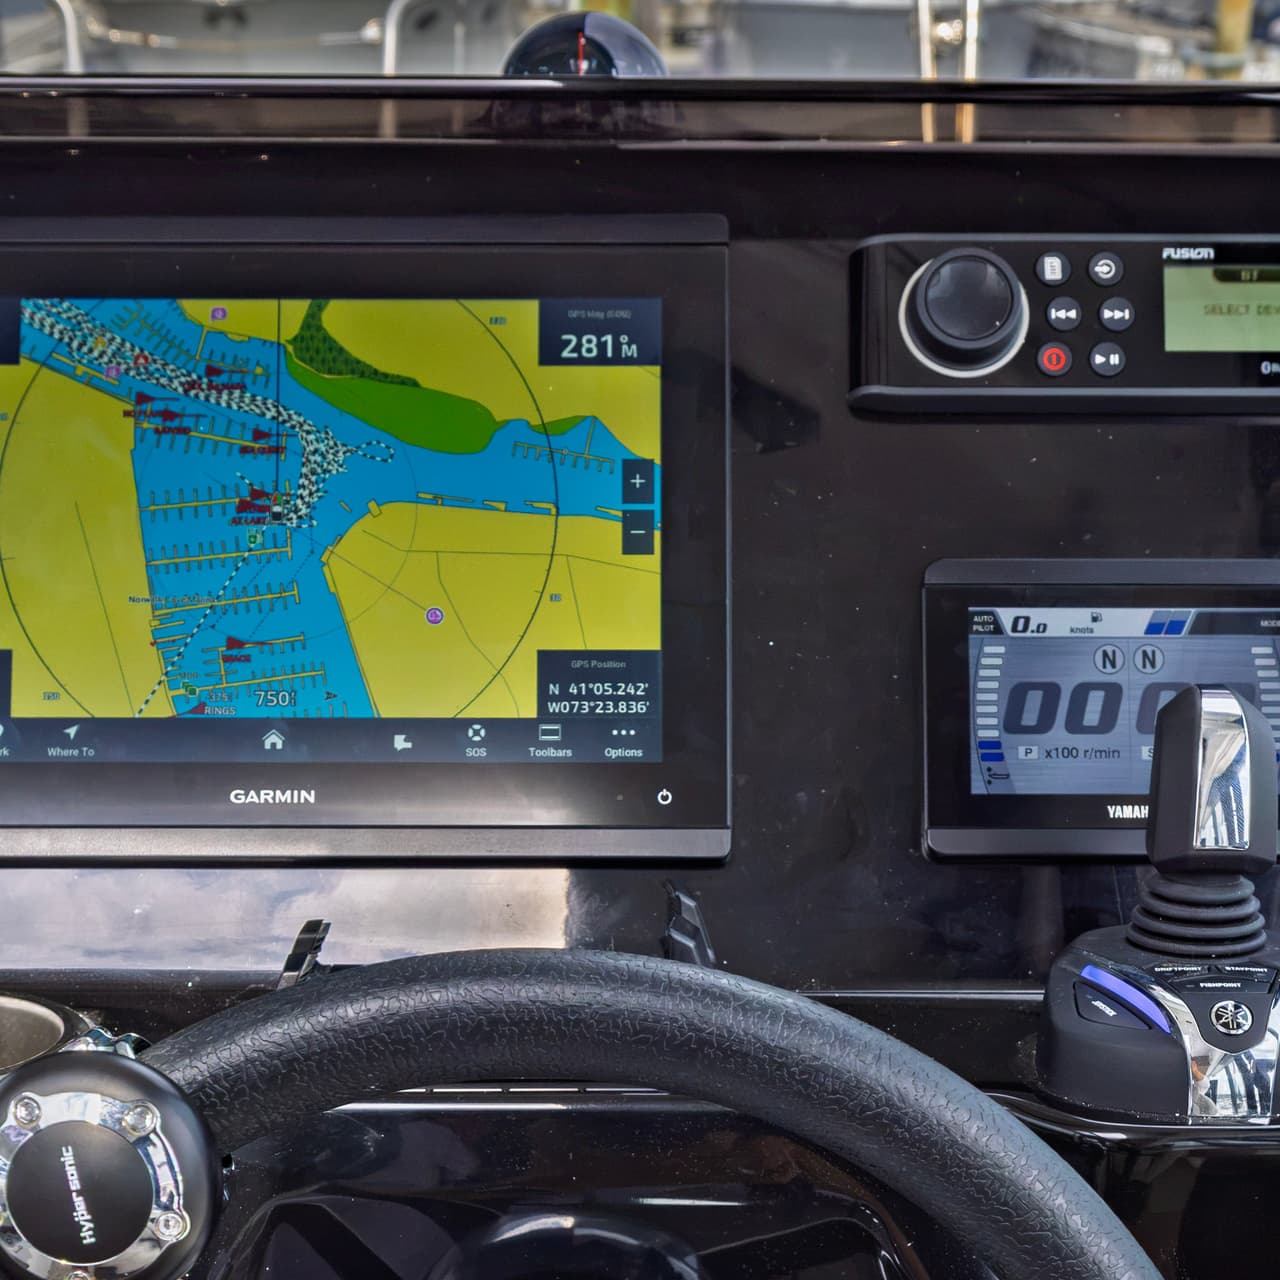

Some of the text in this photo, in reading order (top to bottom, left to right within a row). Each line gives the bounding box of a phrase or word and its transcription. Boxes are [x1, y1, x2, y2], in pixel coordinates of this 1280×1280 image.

[1162, 248, 1214, 259] FUSION
[1204, 304, 1250, 316] SELECT
[560, 334, 613, 358] 281
[972, 614, 995, 623] AUTO
[972, 624, 995, 632] PILOT
[1010, 616, 1048, 634] 0.0
[1070, 626, 1095, 634] knots
[571, 660, 627, 669] GPS Position
[1101, 649, 1157, 669] N N
[549, 682, 649, 695] N 41°05.242'
[254, 690, 290, 706] 750
[204, 706, 236, 716] RINGS
[548, 701, 650, 714] W073°23.836'
[47, 747, 95, 757] Where To
[466, 748, 487, 757] SOS
[528, 747, 573, 757] Toolbars
[604, 748, 643, 758] Options
[1023, 748, 1034, 758] P
[1044, 746, 1120, 760] x100 r/min
[229, 789, 316, 804] GARMIN
[1107, 805, 1149, 819] YAMAH
